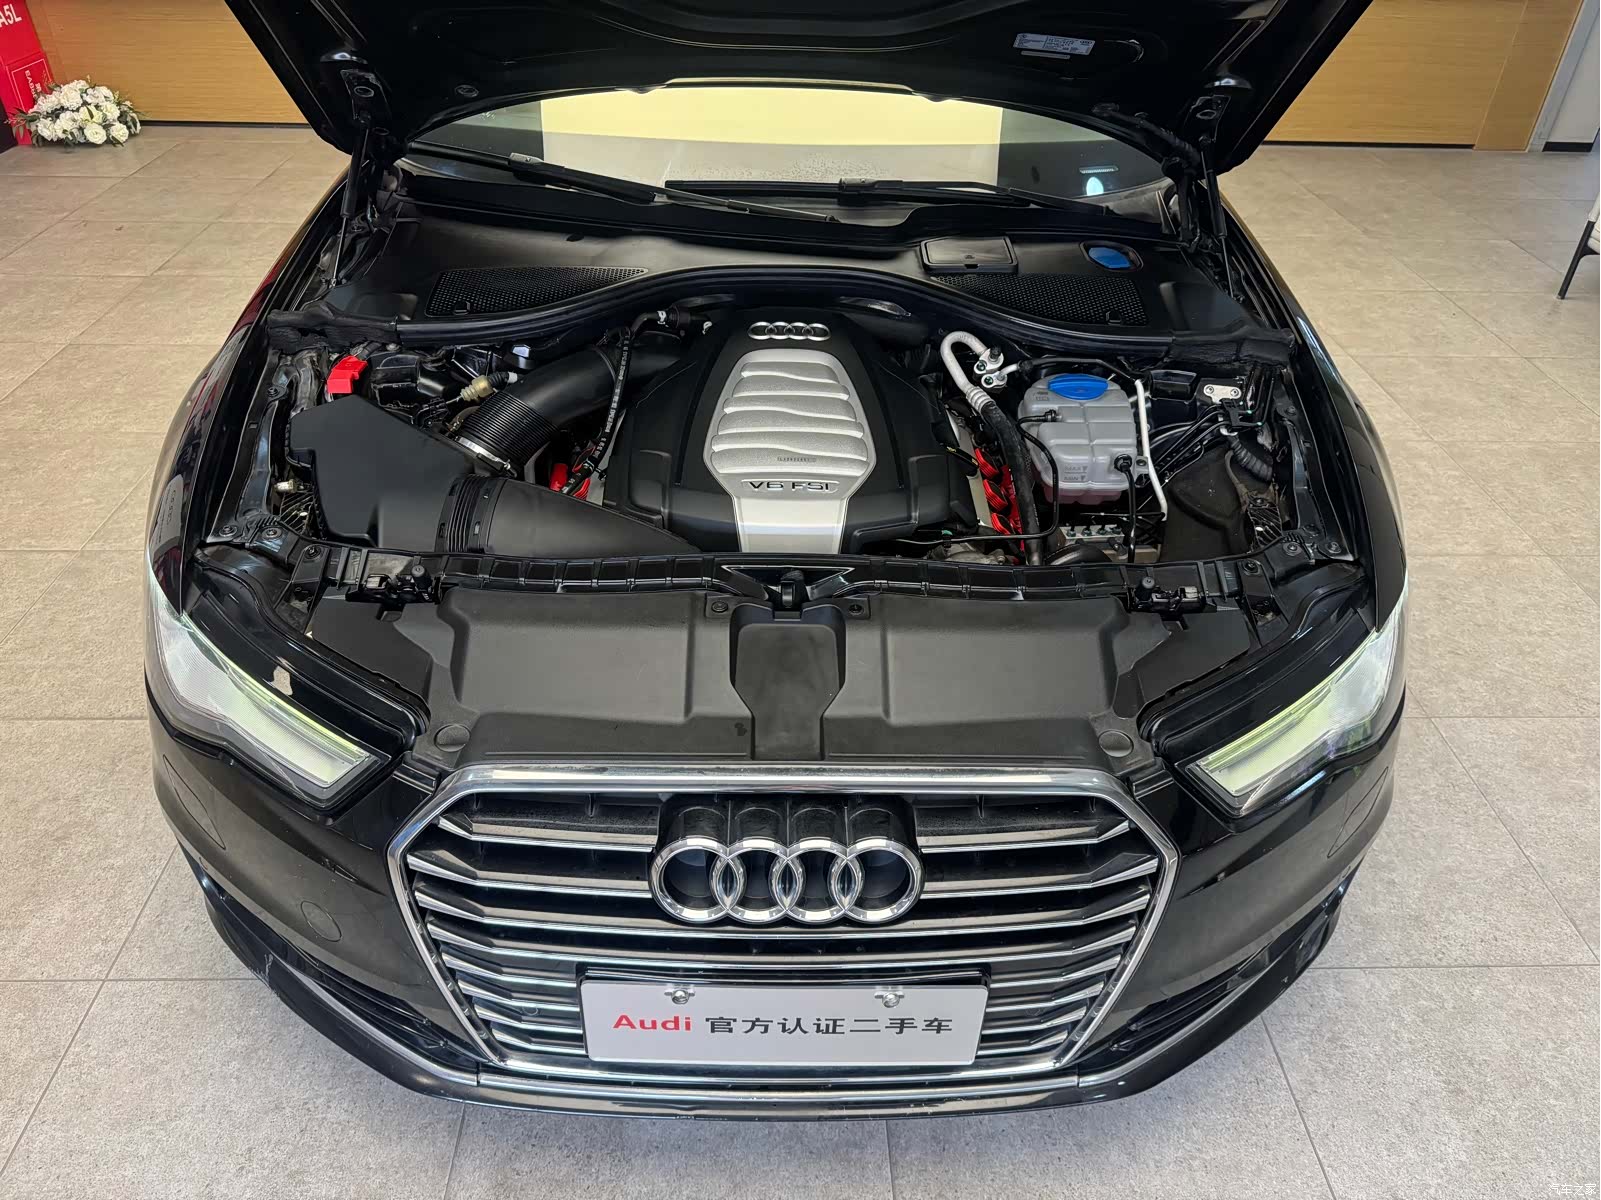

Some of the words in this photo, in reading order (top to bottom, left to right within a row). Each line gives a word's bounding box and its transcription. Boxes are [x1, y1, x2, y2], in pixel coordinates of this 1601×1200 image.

[0, 3, 22, 28] A5L
[748, 480, 784, 491] V6
[791, 481, 829, 492] FSI
[612, 1014, 692, 1032] Audi
[705, 1017, 953, 1035] 官方认证二手车
